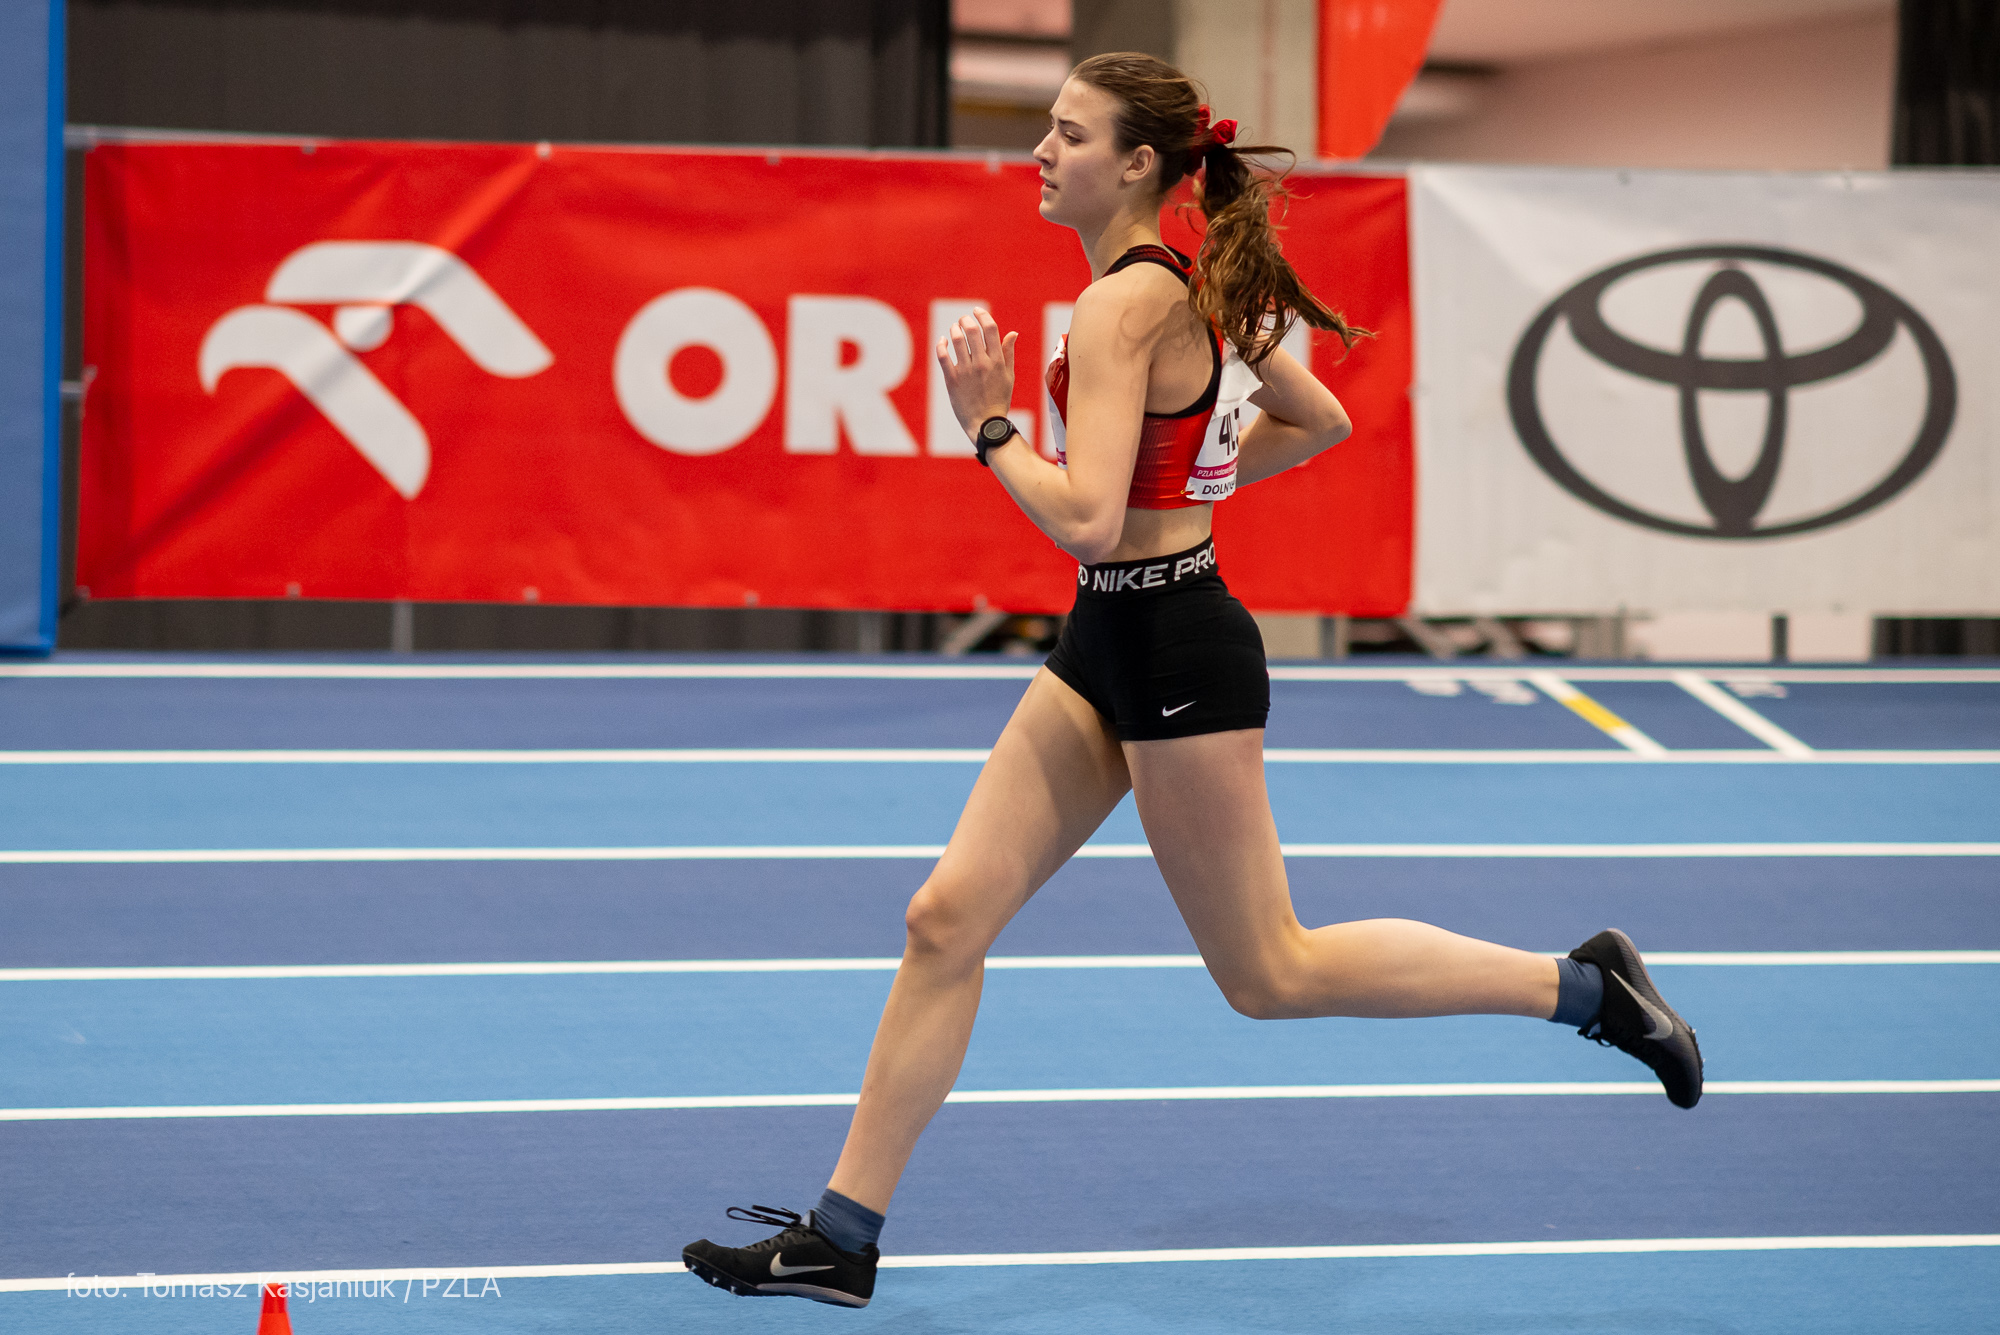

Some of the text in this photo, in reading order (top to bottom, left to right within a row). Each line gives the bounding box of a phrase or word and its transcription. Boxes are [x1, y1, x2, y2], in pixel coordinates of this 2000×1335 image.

[616, 287, 1310, 462] ORL
[1092, 563, 1169, 592] NIKE
[1174, 543, 1215, 582] PRO
